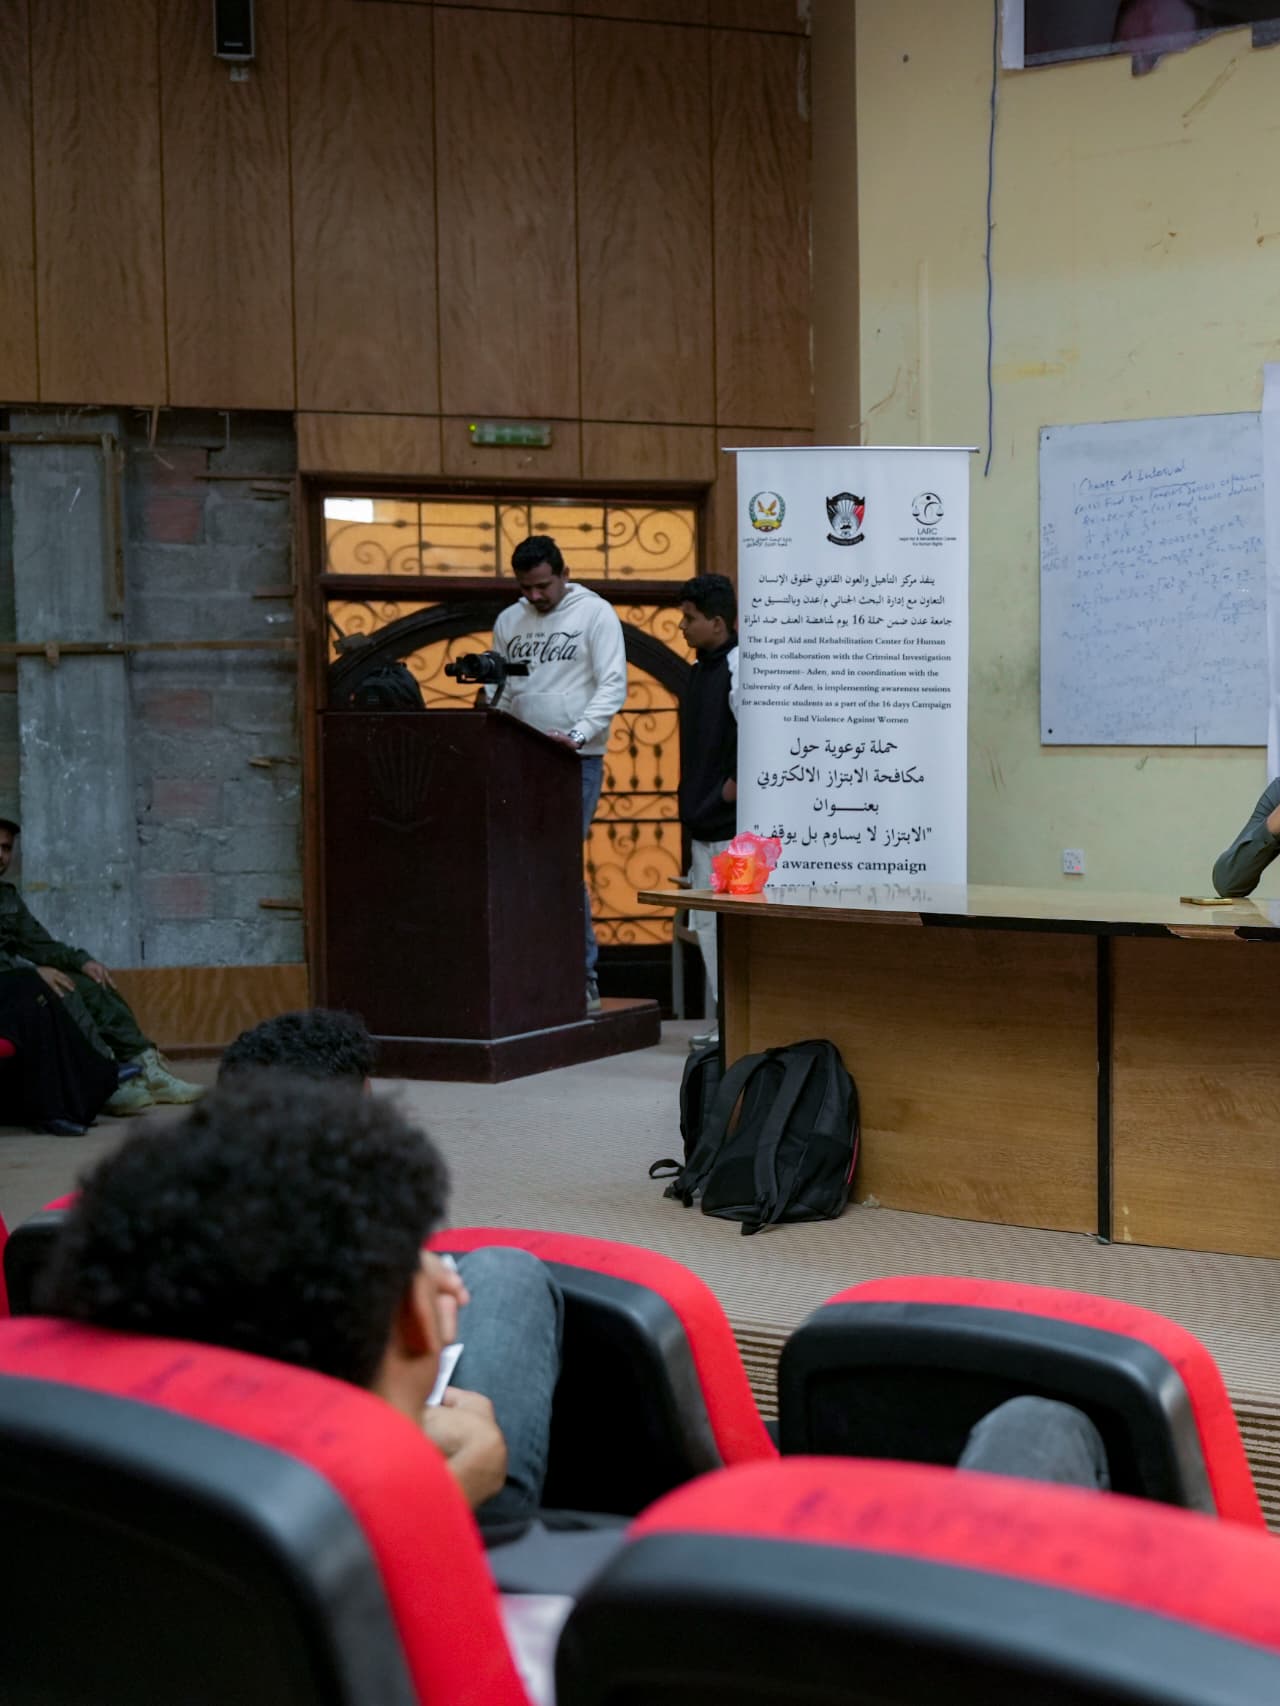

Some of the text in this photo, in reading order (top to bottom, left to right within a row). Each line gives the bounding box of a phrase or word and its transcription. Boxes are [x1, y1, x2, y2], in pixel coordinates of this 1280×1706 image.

[917, 527, 938, 536] LARC
[900, 573, 917, 588] مركز
[919, 575, 935, 587] ينفذ
[751, 597, 762, 608] مع
[859, 594, 884, 606] البحث
[906, 599, 917, 610] مع
[763, 615, 778, 624] ضد
[852, 614, 865, 625] 16
[867, 615, 884, 625] حملة
[886, 617, 908, 629] ضمن
[910, 616, 928, 626] عدن
[930, 616, 953, 627] جامعة
[747, 635, 946, 646] The Legal Aid and Rehabilitation Center for Human
[742, 651, 952, 663] Rights, in collaboration with the Criminal Investigation
[831, 668, 939, 677] and in coordination with the
[742, 682, 952, 694] University of implementing awareness sessions
[741, 698, 752, 707] for
[753, 698, 790, 707] academic
[792, 699, 824, 707] students
[840, 699, 857, 709] part
[868, 699, 880, 708] the
[882, 700, 892, 708] 16
[892, 700, 910, 710] days
[911, 700, 952, 711] Campaign
[783, 714, 909, 725] to End Violence Against Women
[789, 737, 898, 759] حملة توعوية حول
[757, 764, 925, 789] مكافحة الابتزاز الالكتروني
[801, 825, 818, 847] بل
[822, 826, 862, 848] يساوم
[866, 825, 878, 842] لا
[782, 859, 853, 871] awareness
[857, 858, 928, 875] campaign
